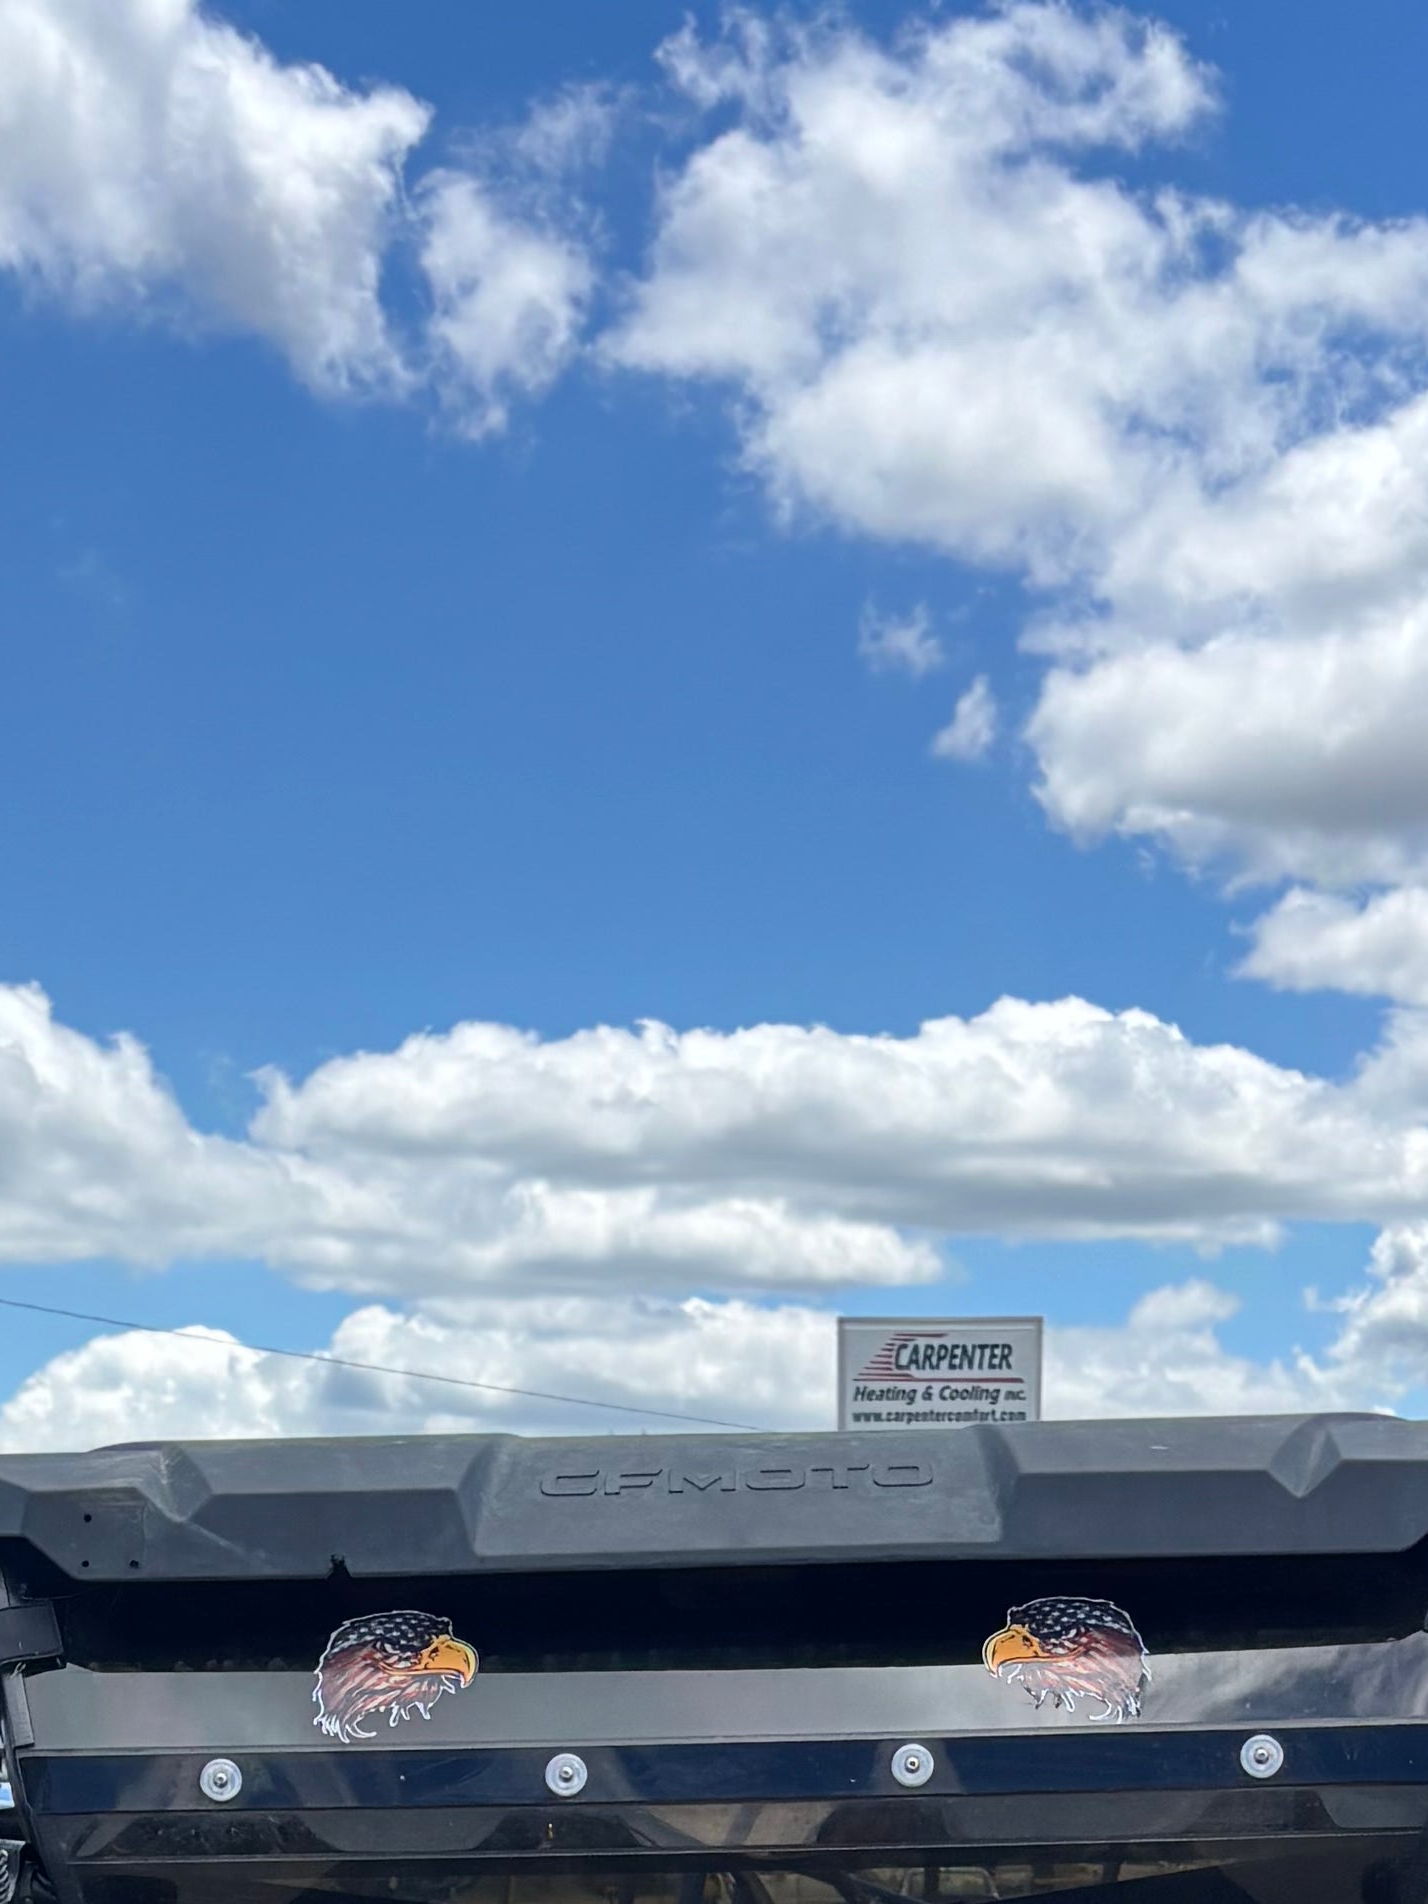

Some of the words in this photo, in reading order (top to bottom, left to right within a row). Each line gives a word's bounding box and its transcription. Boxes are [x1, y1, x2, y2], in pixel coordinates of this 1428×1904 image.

[893, 1343, 1013, 1370] CARPENTER
[852, 1385, 917, 1405] Heating
[922, 1385, 933, 1401] &
[938, 1385, 1001, 1405] Cooling
[539, 1463, 934, 1497] CFMOTO
